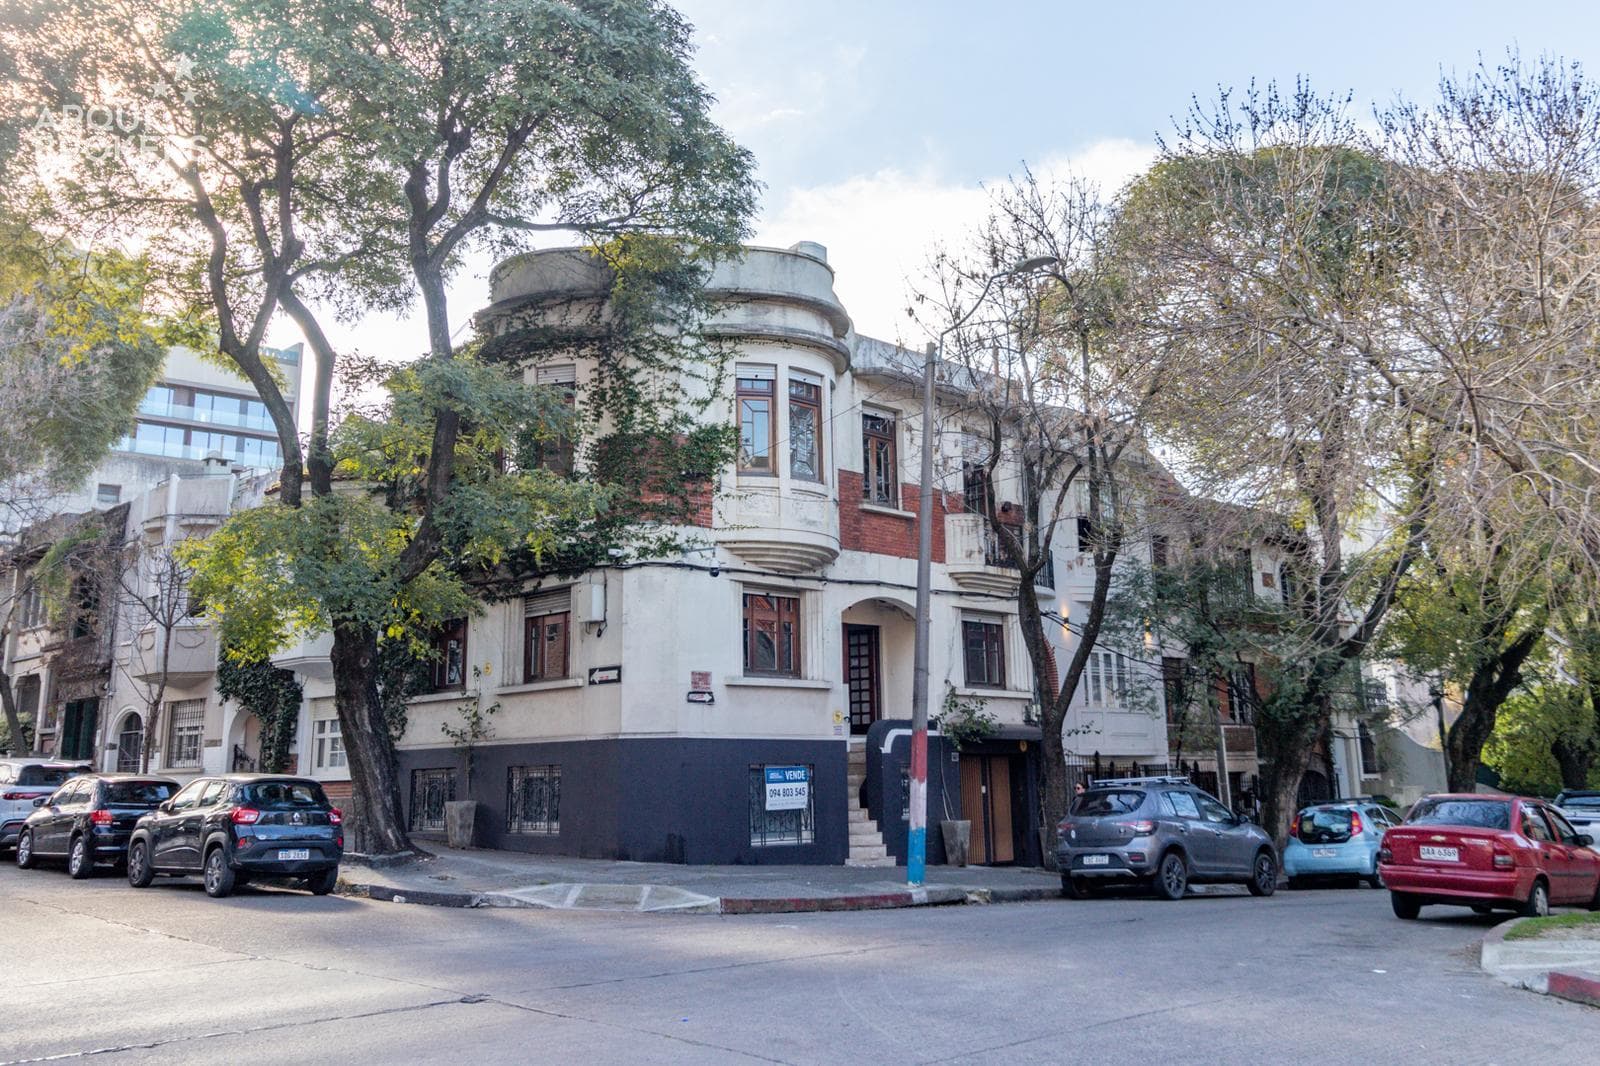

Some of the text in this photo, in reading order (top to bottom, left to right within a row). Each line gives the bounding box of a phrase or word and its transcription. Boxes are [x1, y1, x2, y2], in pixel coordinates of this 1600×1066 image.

[784, 770, 806, 780] VENDE
[769, 787, 806, 798] 094 803 545
